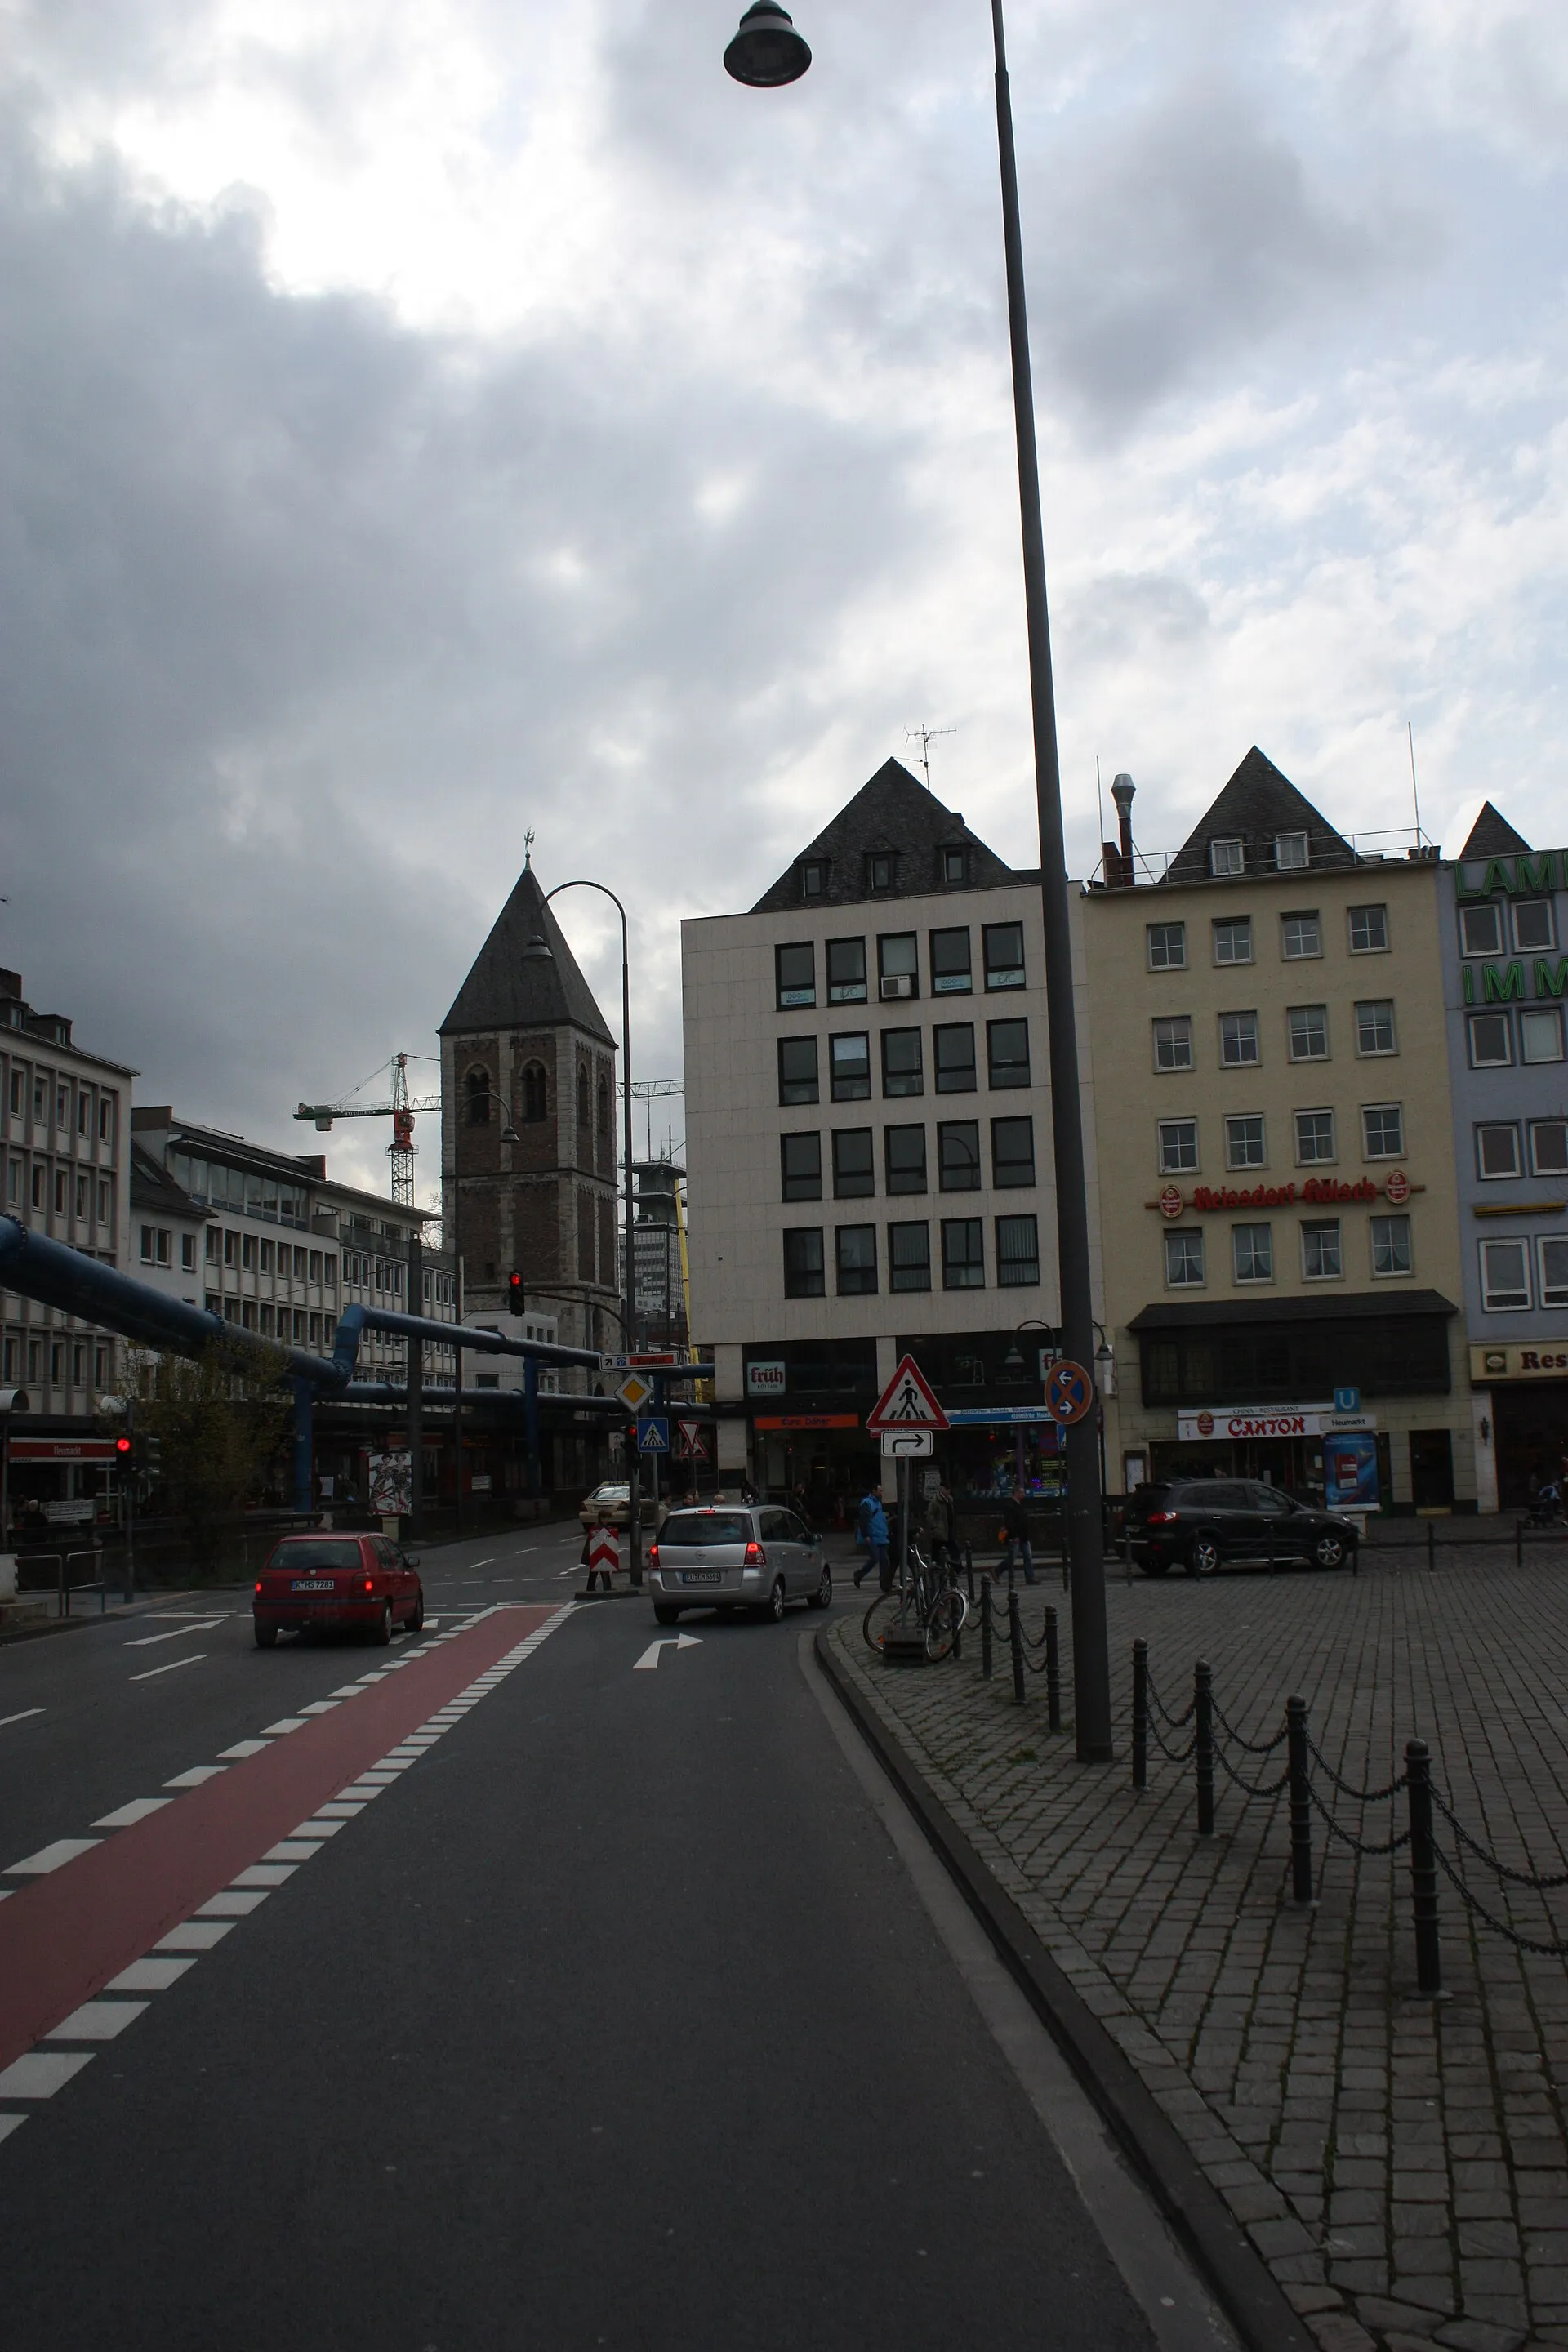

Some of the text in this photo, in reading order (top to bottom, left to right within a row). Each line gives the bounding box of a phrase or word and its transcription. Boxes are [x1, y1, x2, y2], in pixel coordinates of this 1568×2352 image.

[1521, 1352, 1568, 1369] Res
[751, 1366, 783, 1384] früh
[1339, 1391, 1355, 1410] U
[1227, 1416, 1304, 1437] CANTON
[53, 1445, 82, 1455] Heumarkt
